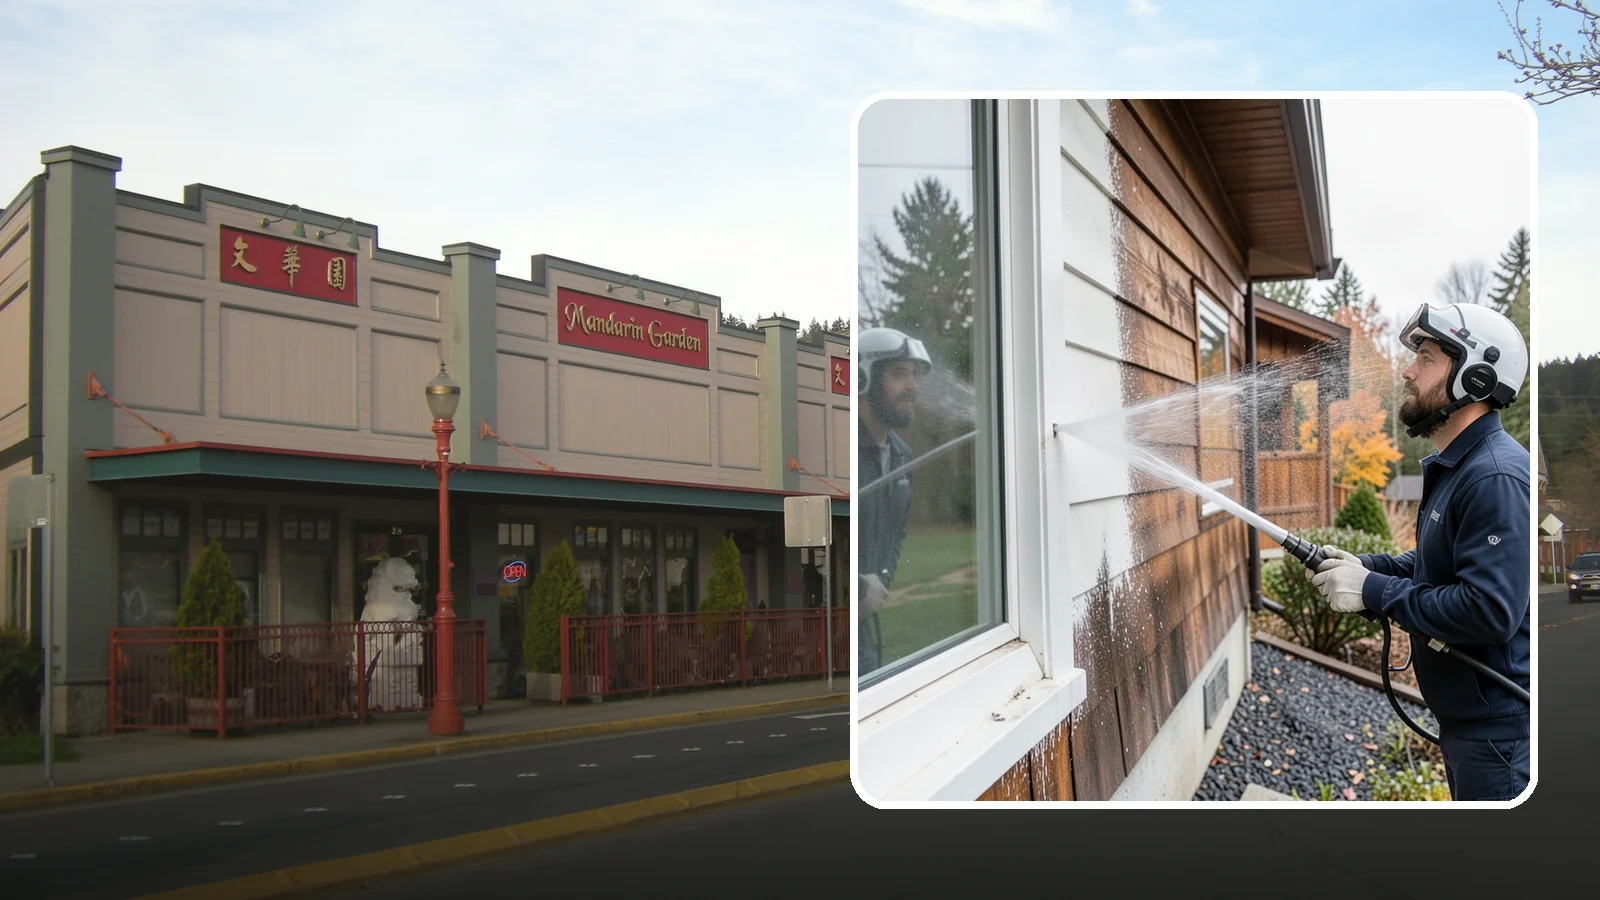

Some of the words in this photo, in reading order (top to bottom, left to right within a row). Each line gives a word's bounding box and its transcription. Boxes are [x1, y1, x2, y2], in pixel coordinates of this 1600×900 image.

[231, 236, 346, 290] 文華園
[565, 303, 644, 341] Mandarin
[648, 321, 701, 352] Garden
[503, 565, 527, 578] OPEN
